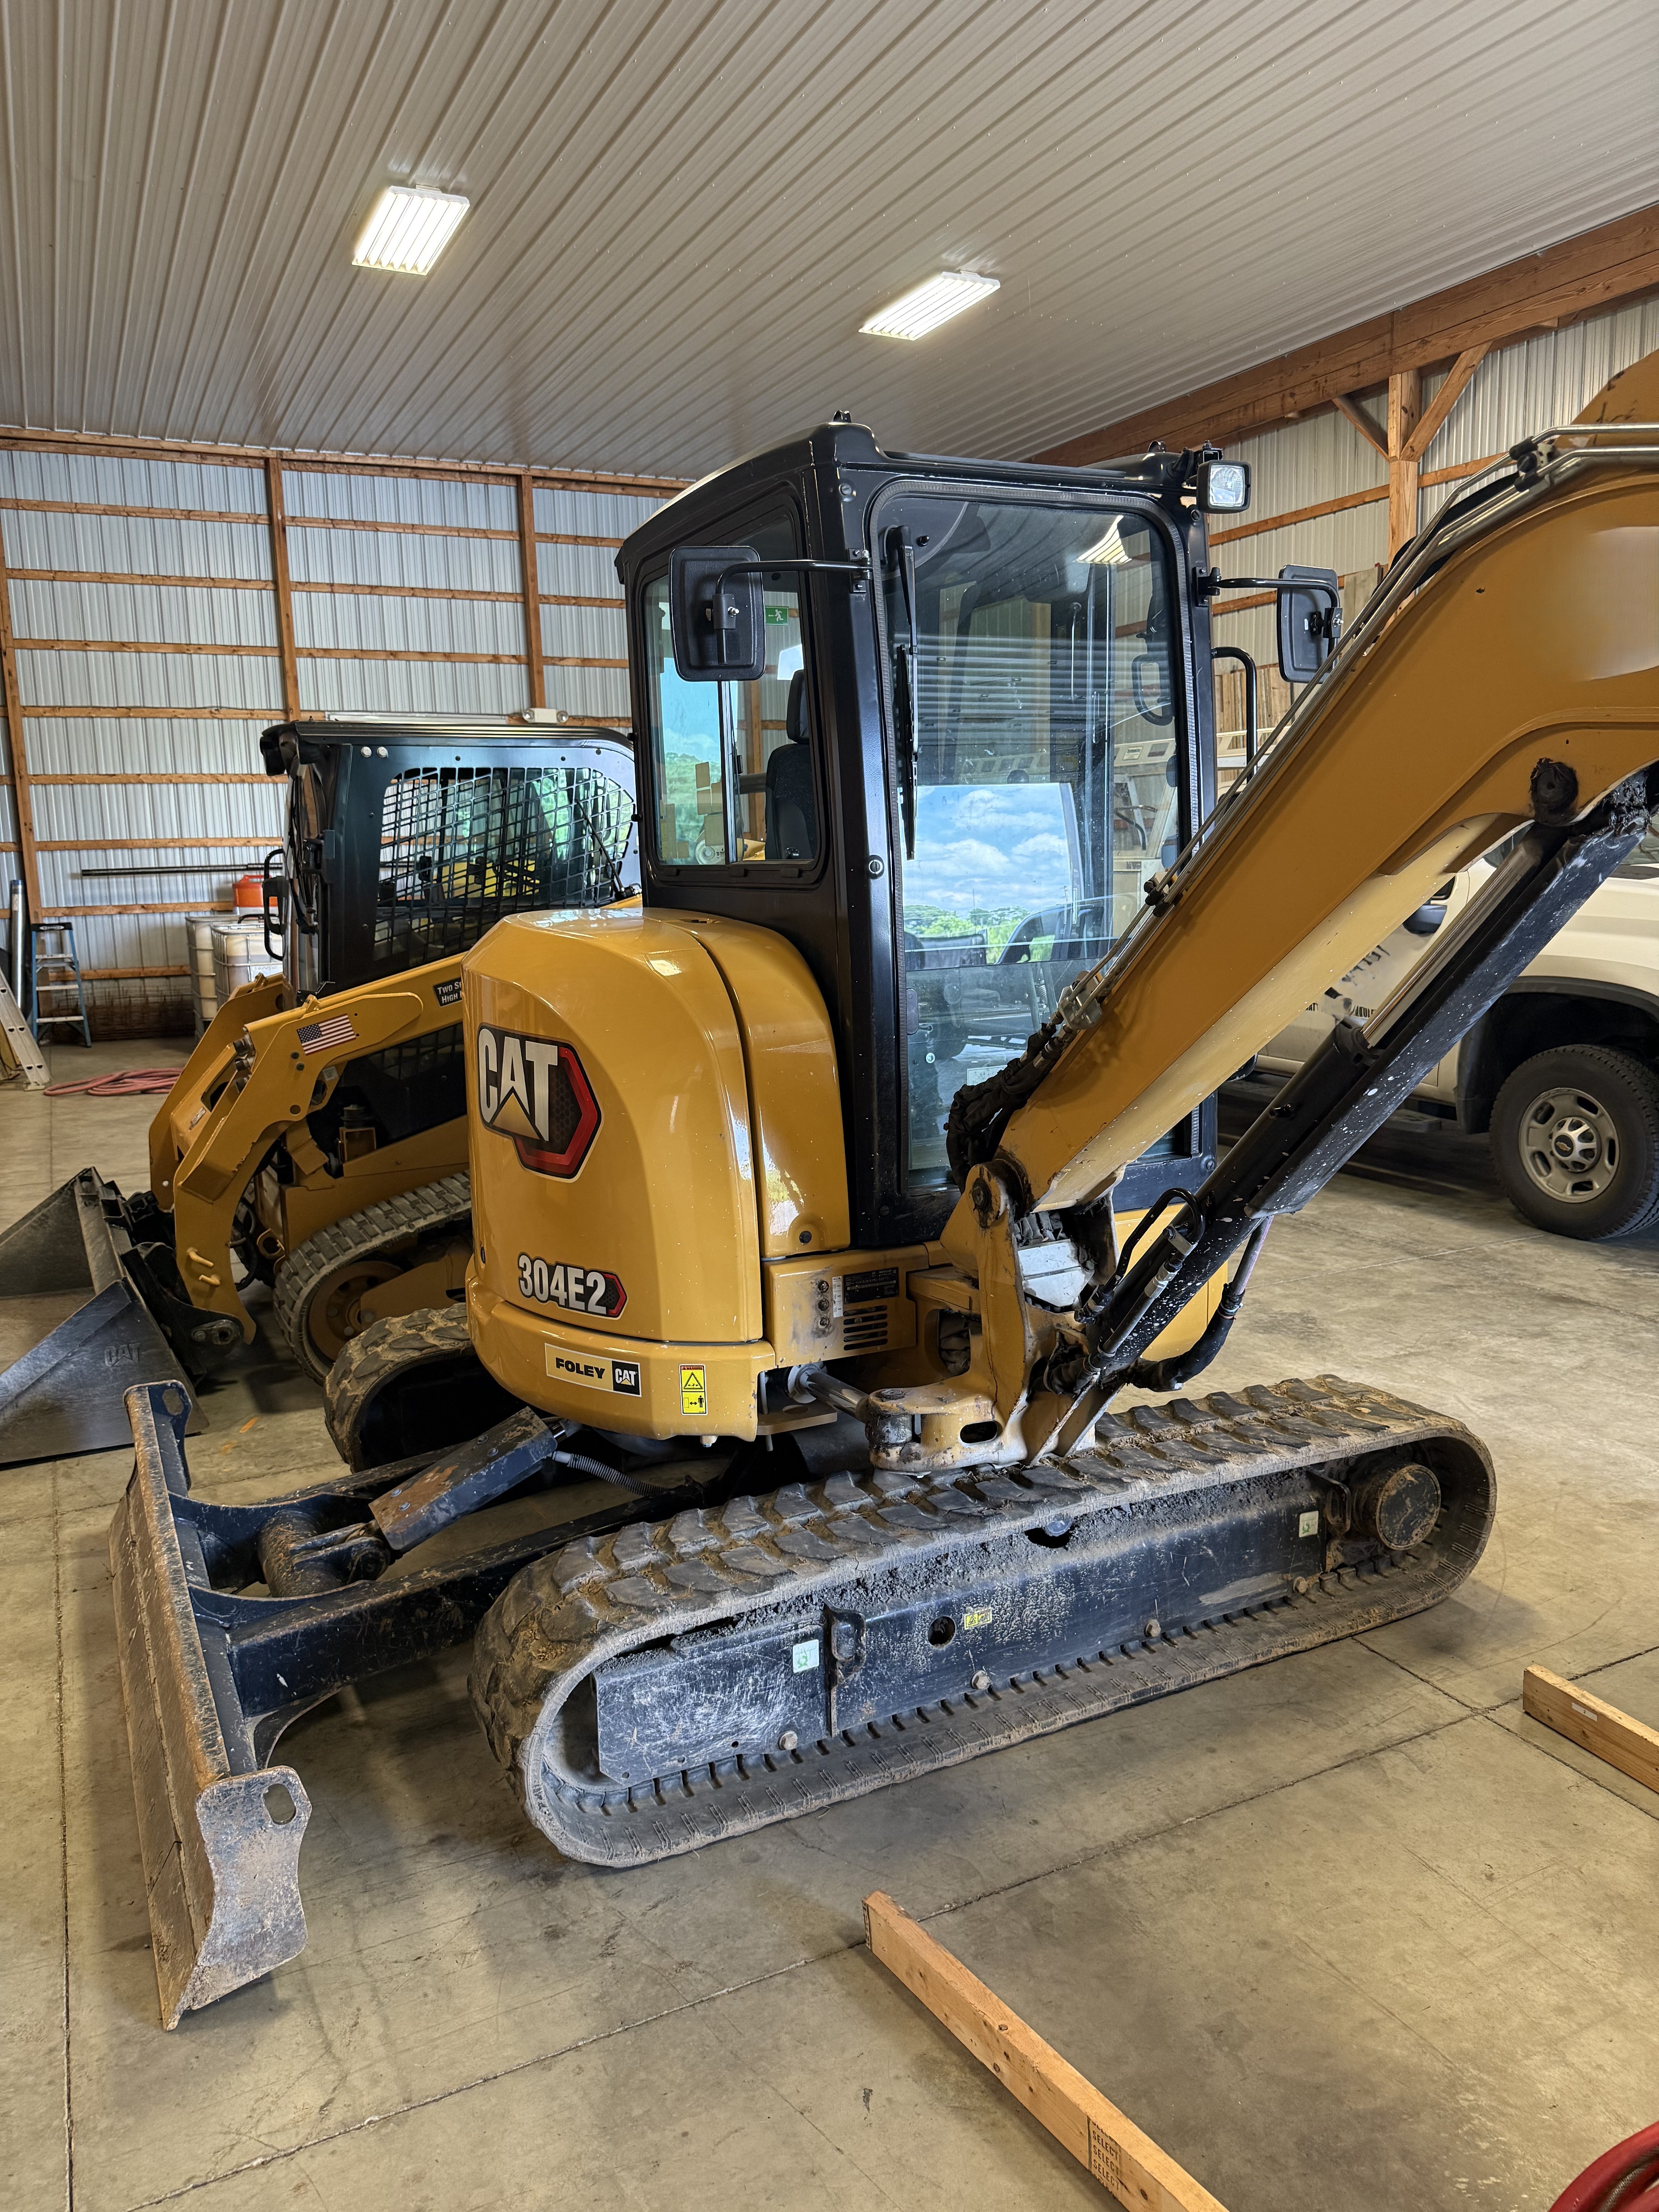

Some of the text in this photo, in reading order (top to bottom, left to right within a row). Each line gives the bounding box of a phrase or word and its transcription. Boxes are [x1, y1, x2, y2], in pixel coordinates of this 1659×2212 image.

[437, 984, 453, 995] TWO
[441, 993, 458, 1004] HIGH
[479, 1028, 558, 1142] CAT
[519, 1255, 606, 1315] 304E2
[104, 1343, 141, 1367] CAT
[556, 1357, 636, 1386] FOLEY CAT
[1092, 2130, 1118, 2160] SELECT
[1093, 2145, 1119, 2175] SELECT
[1093, 2159, 1119, 2191] SELECT
